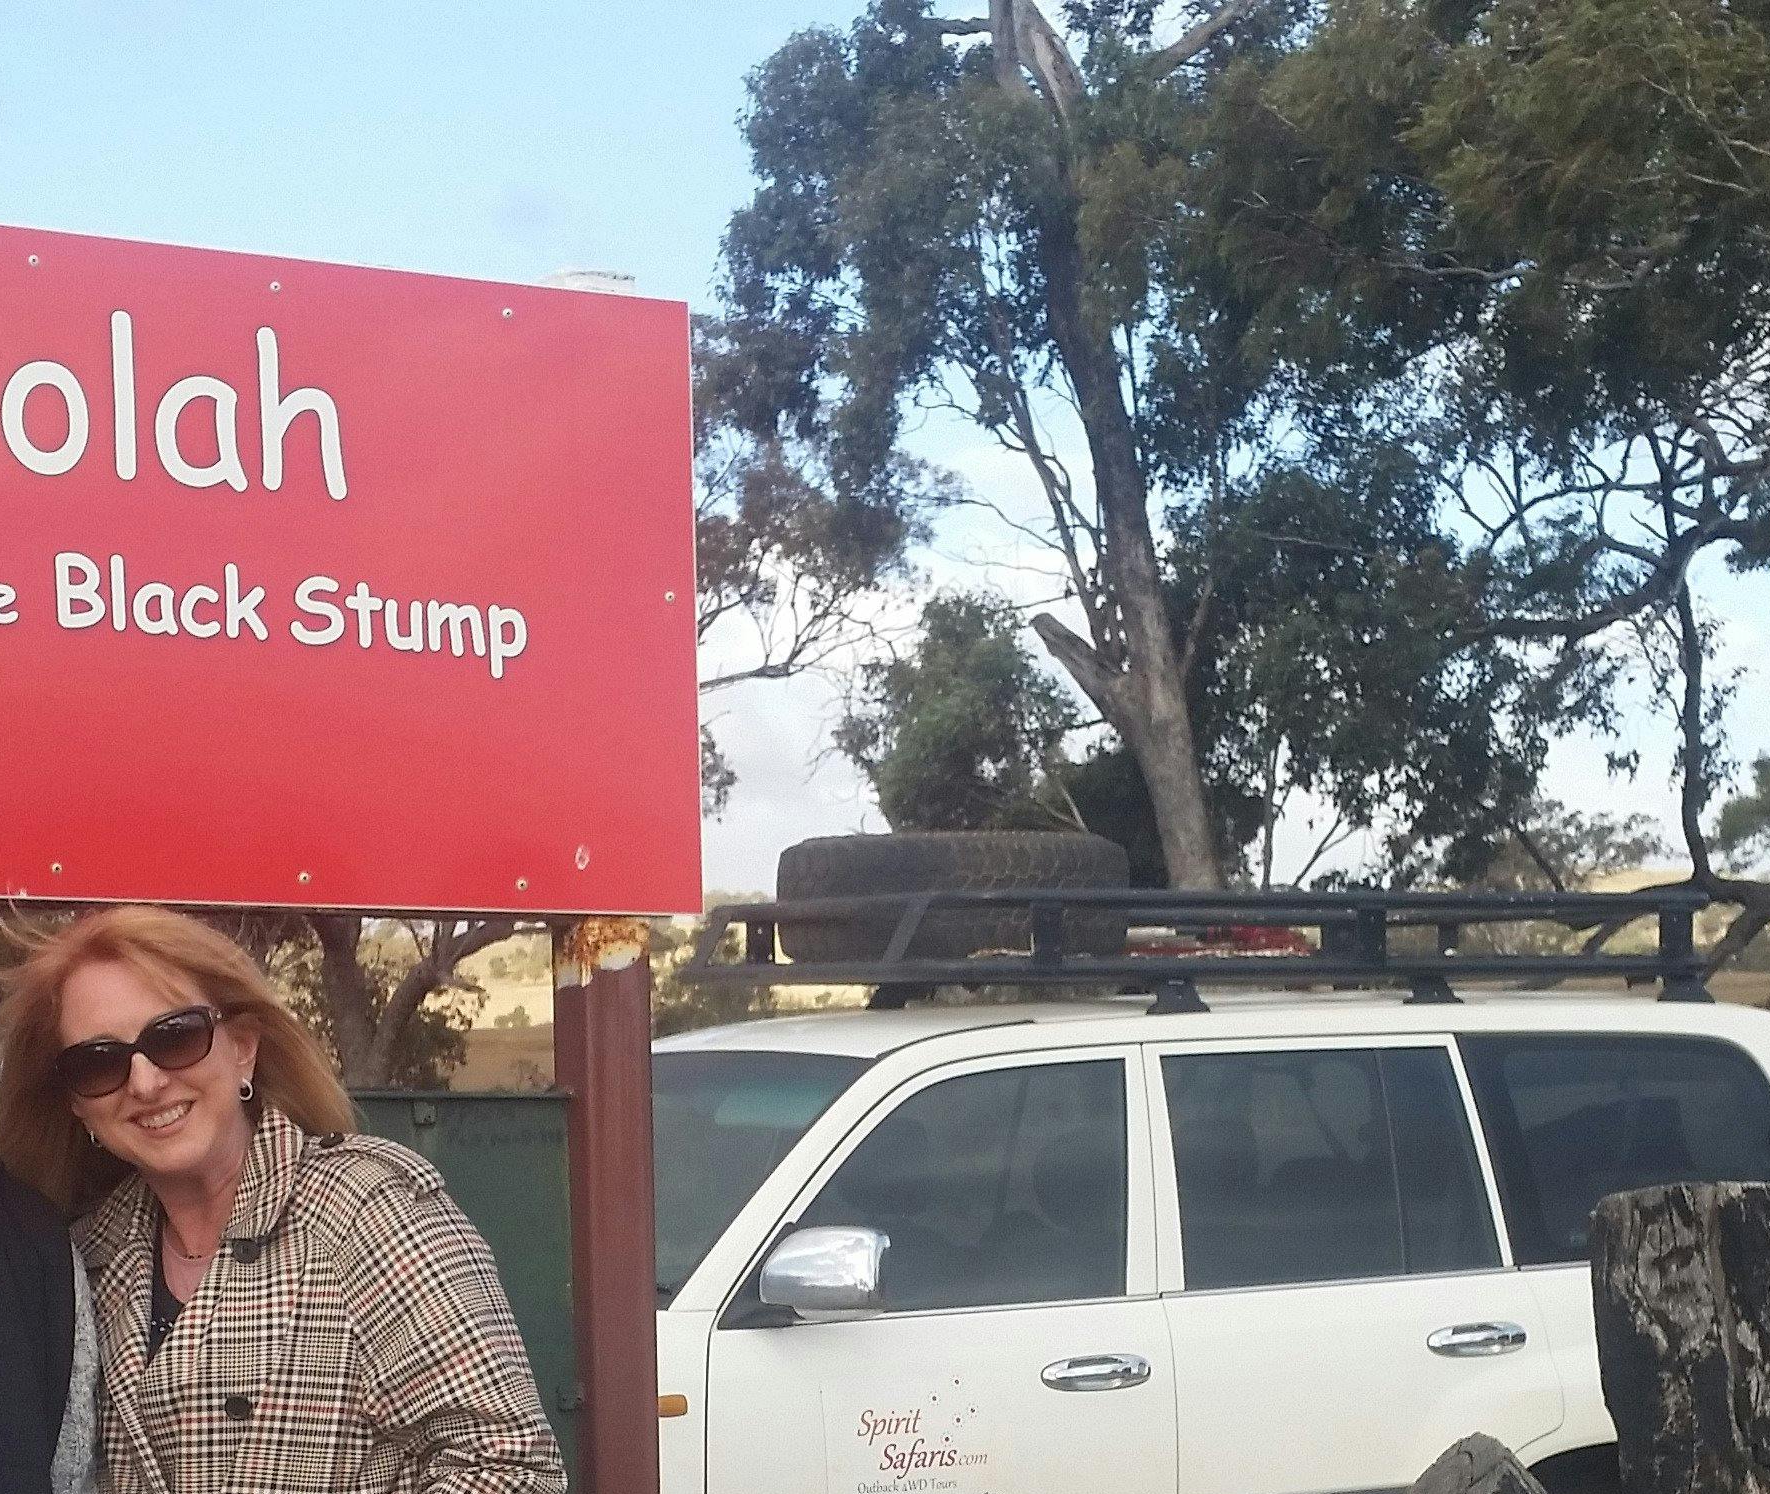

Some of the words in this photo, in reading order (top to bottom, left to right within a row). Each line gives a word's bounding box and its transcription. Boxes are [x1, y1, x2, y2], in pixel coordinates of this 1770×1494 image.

[53, 551, 270, 642] Black
[289, 574, 529, 680] Stump
[857, 1408, 922, 1446] Spirit
[879, 1438, 988, 1480] Safaris.com
[857, 1479, 899, 1494] Outback
[901, 1479, 928, 1492] 4WD
[930, 1477, 957, 1491] Tours
